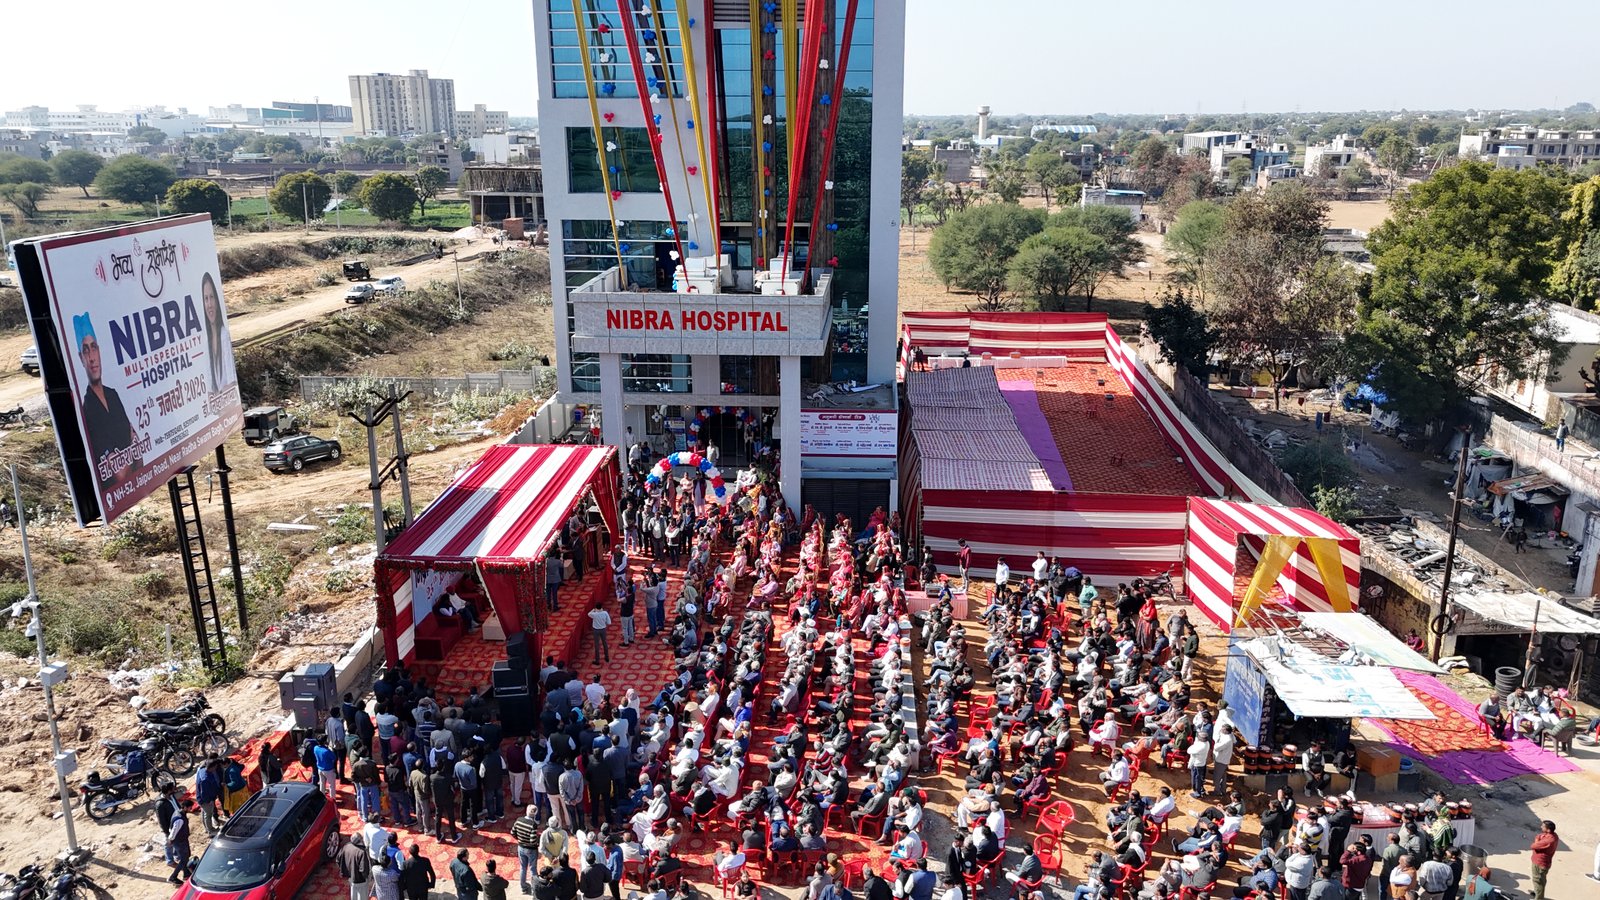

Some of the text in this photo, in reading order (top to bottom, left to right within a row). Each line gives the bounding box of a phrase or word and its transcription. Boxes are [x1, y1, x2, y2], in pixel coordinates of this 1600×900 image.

[111, 240, 180, 298] भव्य शुभारंभ
[108, 295, 202, 365] NIBRA
[606, 309, 788, 332] NIBRA HOSPITAL
[124, 335, 201, 376] MULTISPECIALITY
[141, 352, 193, 389] HOSPITAL
[135, 373, 207, 430] 25th जनवरी 2026
[97, 432, 152, 482] डॉ. राकेश चौधरी
[113, 481, 136, 501] NH-52,
[136, 471, 153, 488] Jaipur
[153, 463, 169, 477] Road,
[169, 453, 182, 467] Near
[182, 442, 197, 459] Radha
[197, 434, 211, 448] Swami
[211, 427, 224, 440] Bagh,
